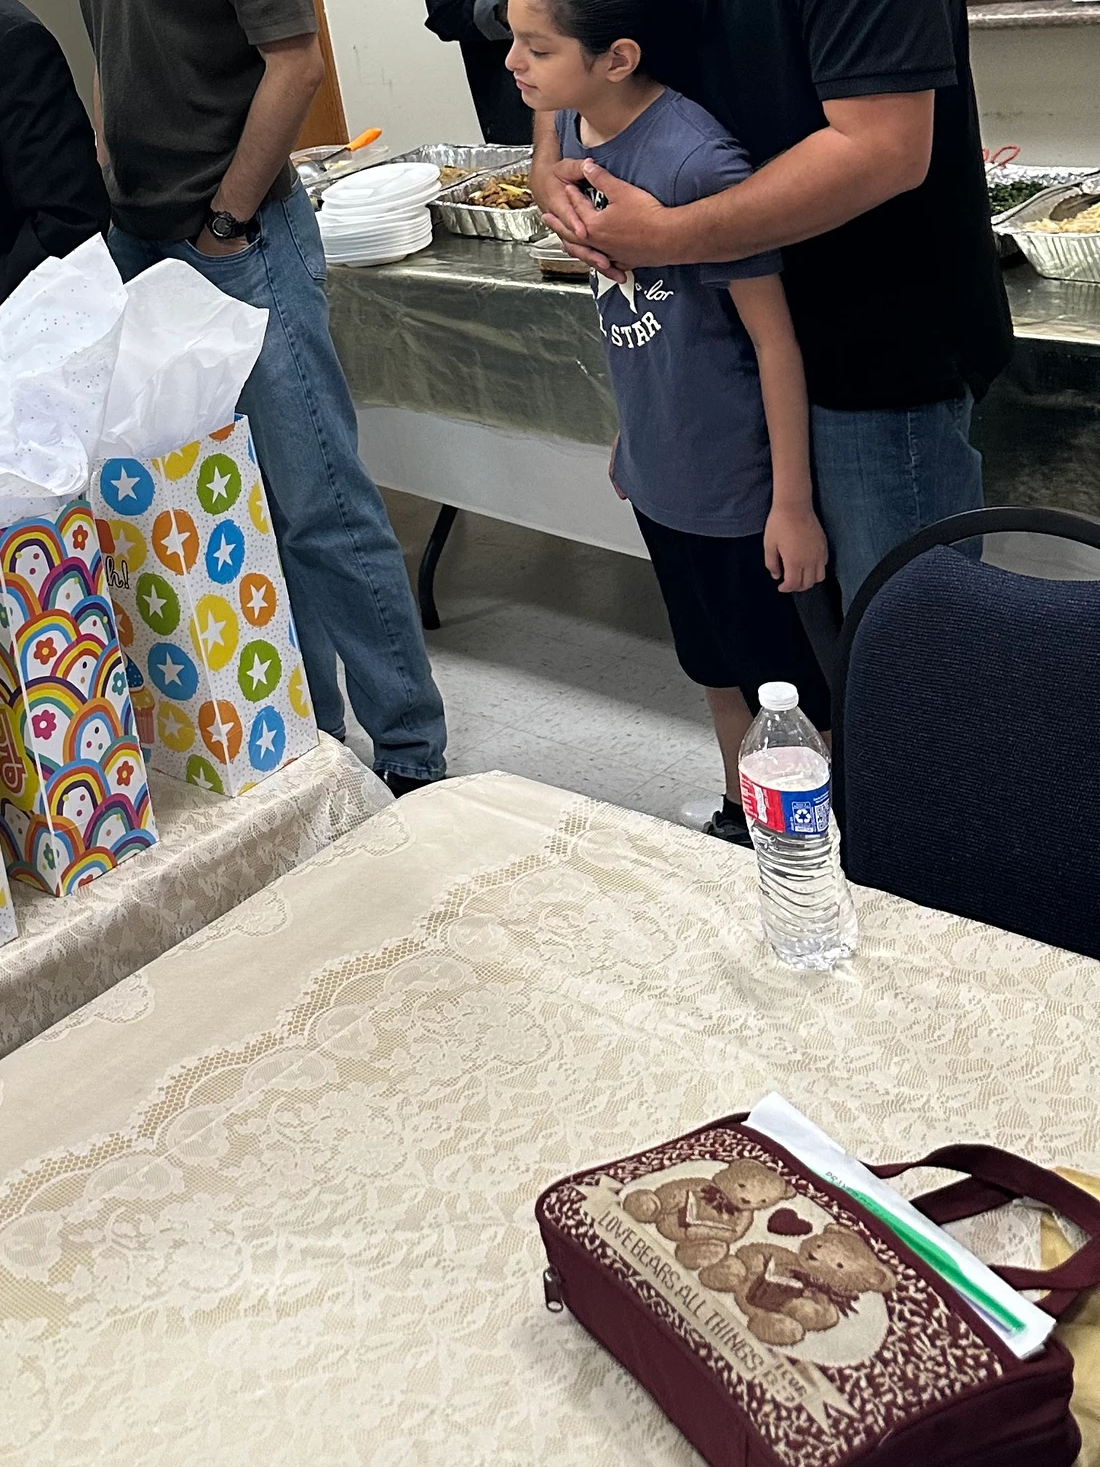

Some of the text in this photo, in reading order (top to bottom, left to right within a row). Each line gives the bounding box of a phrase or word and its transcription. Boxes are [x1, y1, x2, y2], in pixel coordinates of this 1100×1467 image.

[611, 311, 662, 349] STAR
[598, 1210, 764, 1372] LOVE BEARS ALL THINGS
